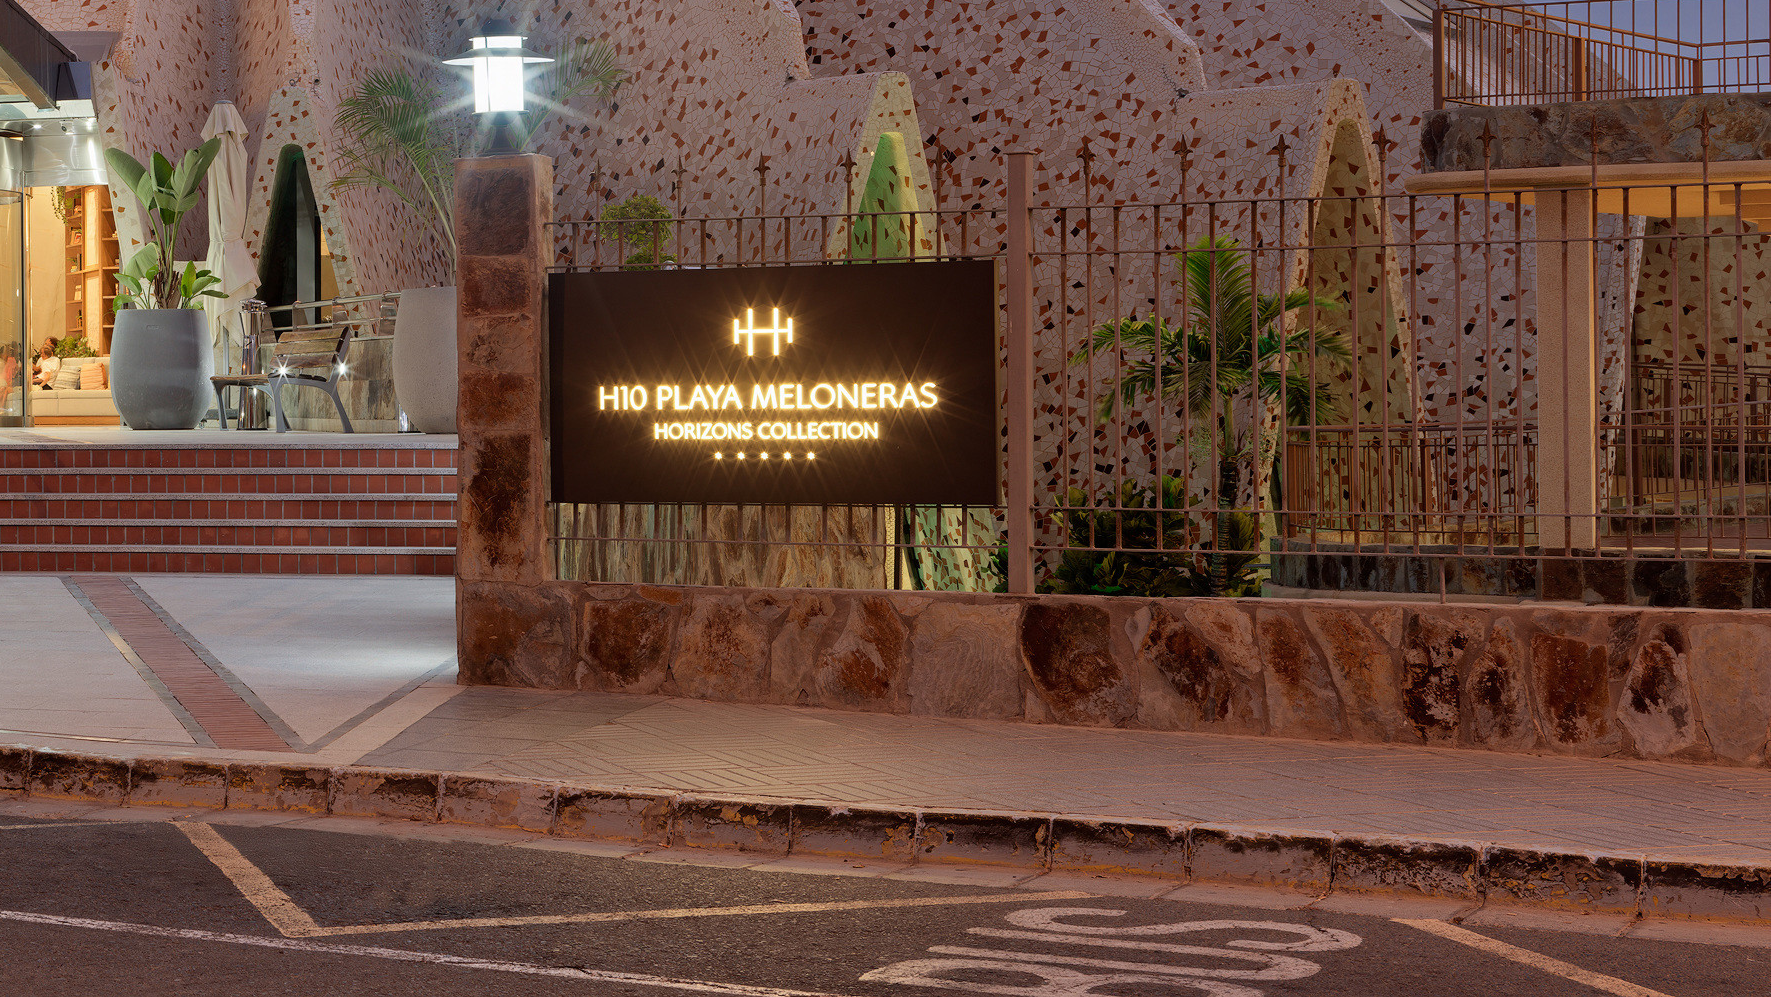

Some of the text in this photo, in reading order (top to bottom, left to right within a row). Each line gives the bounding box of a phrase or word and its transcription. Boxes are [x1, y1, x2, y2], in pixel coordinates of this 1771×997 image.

[599, 382, 939, 410] H10 PLAYA MELONERAS
[654, 421, 880, 440] HORIZONS COLLECTION
